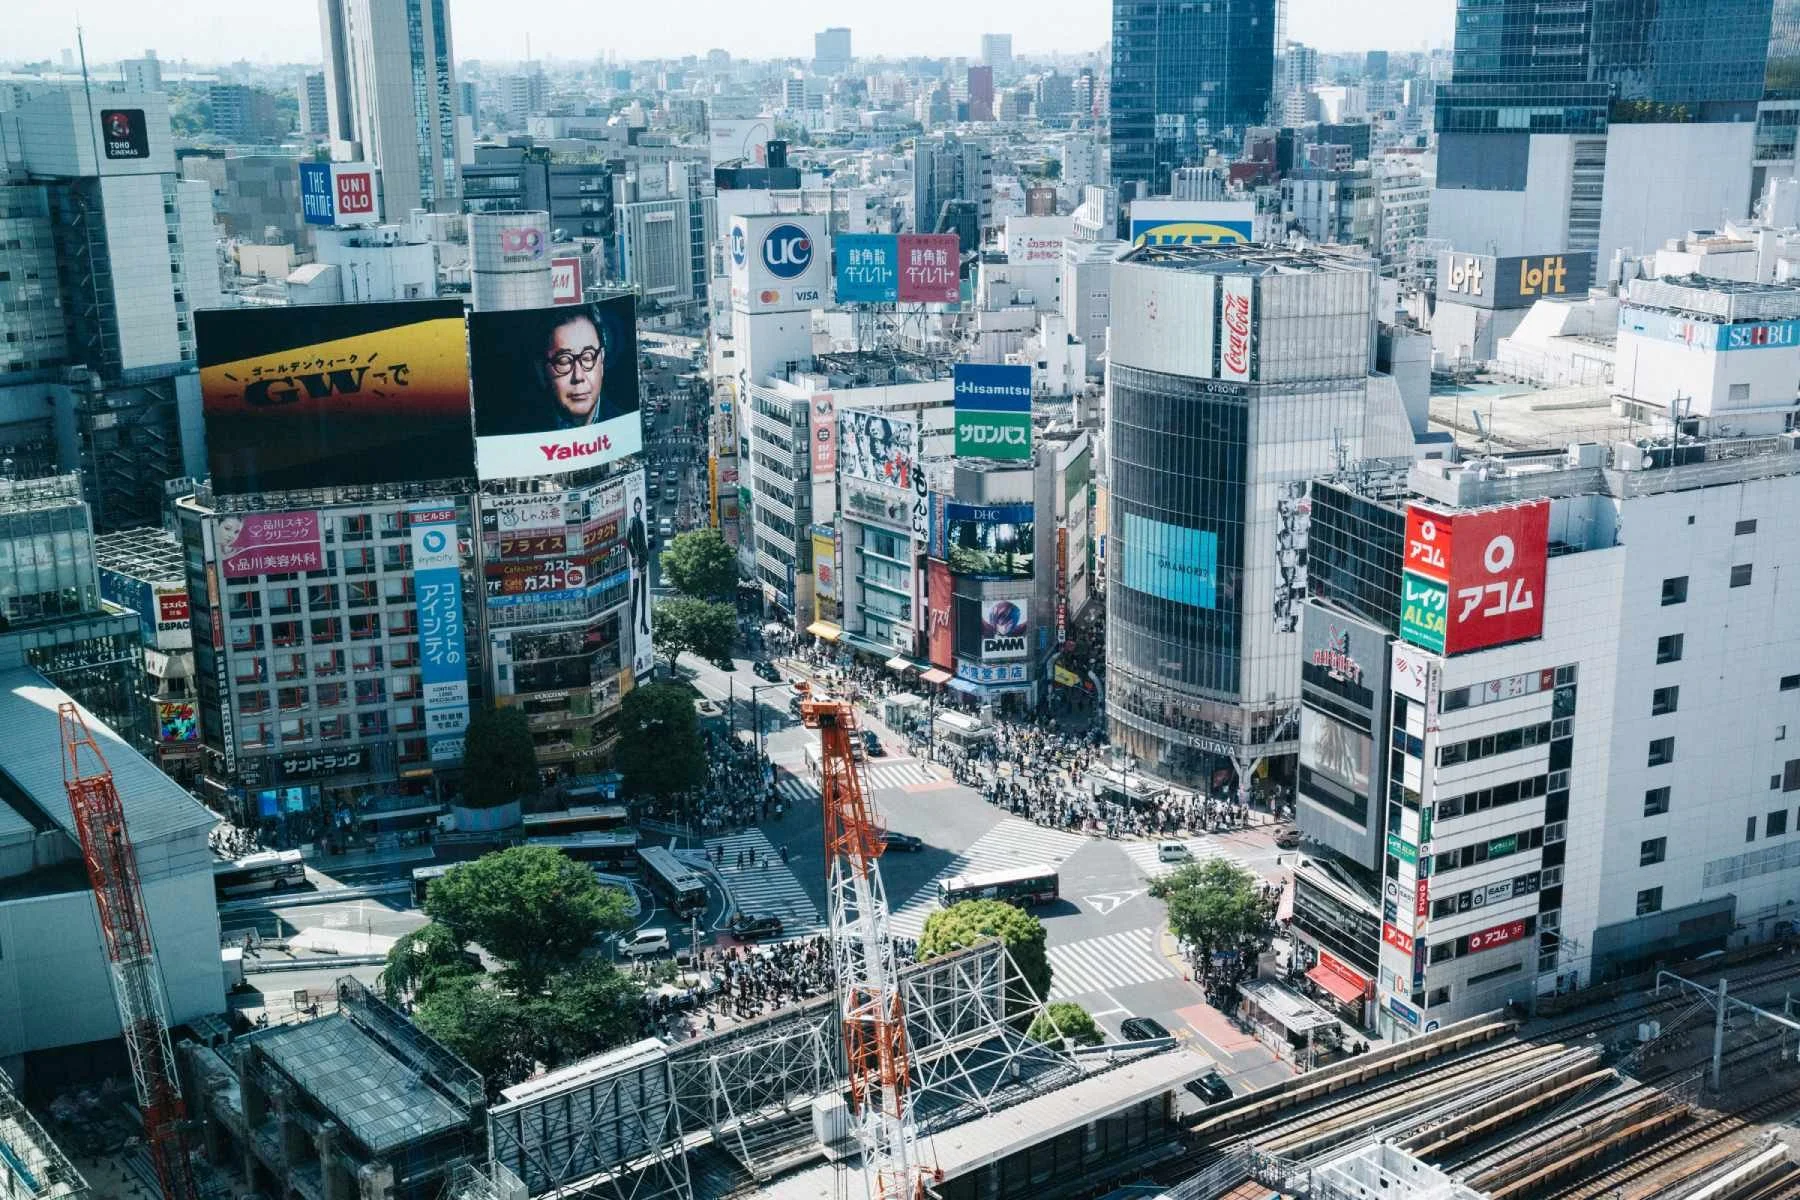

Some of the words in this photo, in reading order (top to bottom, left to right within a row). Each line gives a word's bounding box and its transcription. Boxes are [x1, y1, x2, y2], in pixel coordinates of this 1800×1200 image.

[110, 141, 130, 150] TOHO
[308, 172, 324, 193] THE
[340, 180, 366, 193] UNI
[304, 194, 332, 217] PRIME
[342, 194, 370, 210] QLO
[849, 248, 886, 266] 龍角散
[911, 248, 948, 266] 龍角散
[844, 266, 892, 283] ダイレクト
[906, 266, 954, 284] ダイレクト
[796, 291, 819, 301] VISA
[1729, 326, 1792, 347] SEIBU
[252, 354, 358, 376] ゴールデンウィーク
[956, 382, 1031, 396] Hisamitsu
[959, 424, 1027, 445] サロンパス
[540, 434, 612, 461] Yakult
[263, 517, 313, 531] 品川スキン
[974, 509, 1000, 521] DHC
[266, 528, 309, 541] クリニック
[237, 552, 317, 572] 品川美容外科
[1409, 540, 1446, 568] アコム
[544, 560, 574, 571] ガスト
[487, 580, 502, 591] 7F
[524, 574, 562, 591] ガスト
[1406, 580, 1446, 611] レイク
[1458, 578, 1534, 624] アコム
[420, 584, 442, 664] アイシティ
[442, 584, 460, 664] コンタクトの
[1404, 606, 1445, 635] ALSA
[984, 638, 1025, 652] DMM
[1187, 736, 1235, 756] TSUTAYA
[1488, 884, 1512, 896] EAST
[1484, 932, 1508, 944] アコム
